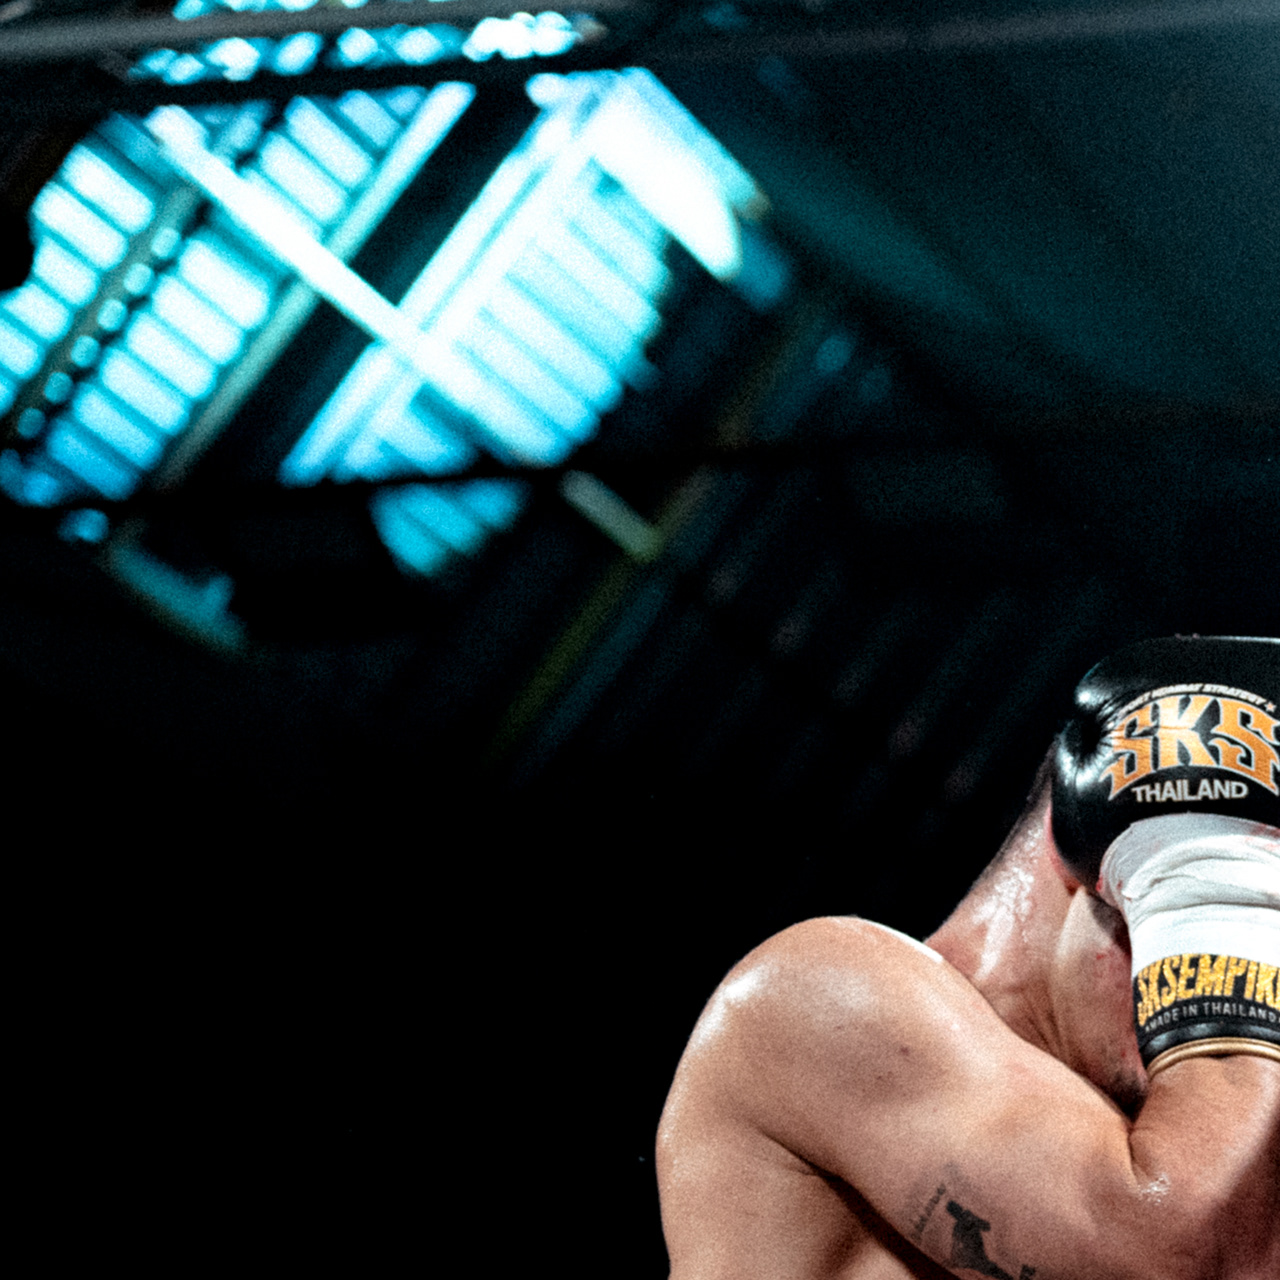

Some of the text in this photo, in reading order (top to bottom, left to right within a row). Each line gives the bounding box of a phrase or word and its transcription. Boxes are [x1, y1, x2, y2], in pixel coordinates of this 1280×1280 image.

[1131, 779, 1249, 803] THAILAND
[1149, 1001, 1276, 1028] MADE IN THAILAND
